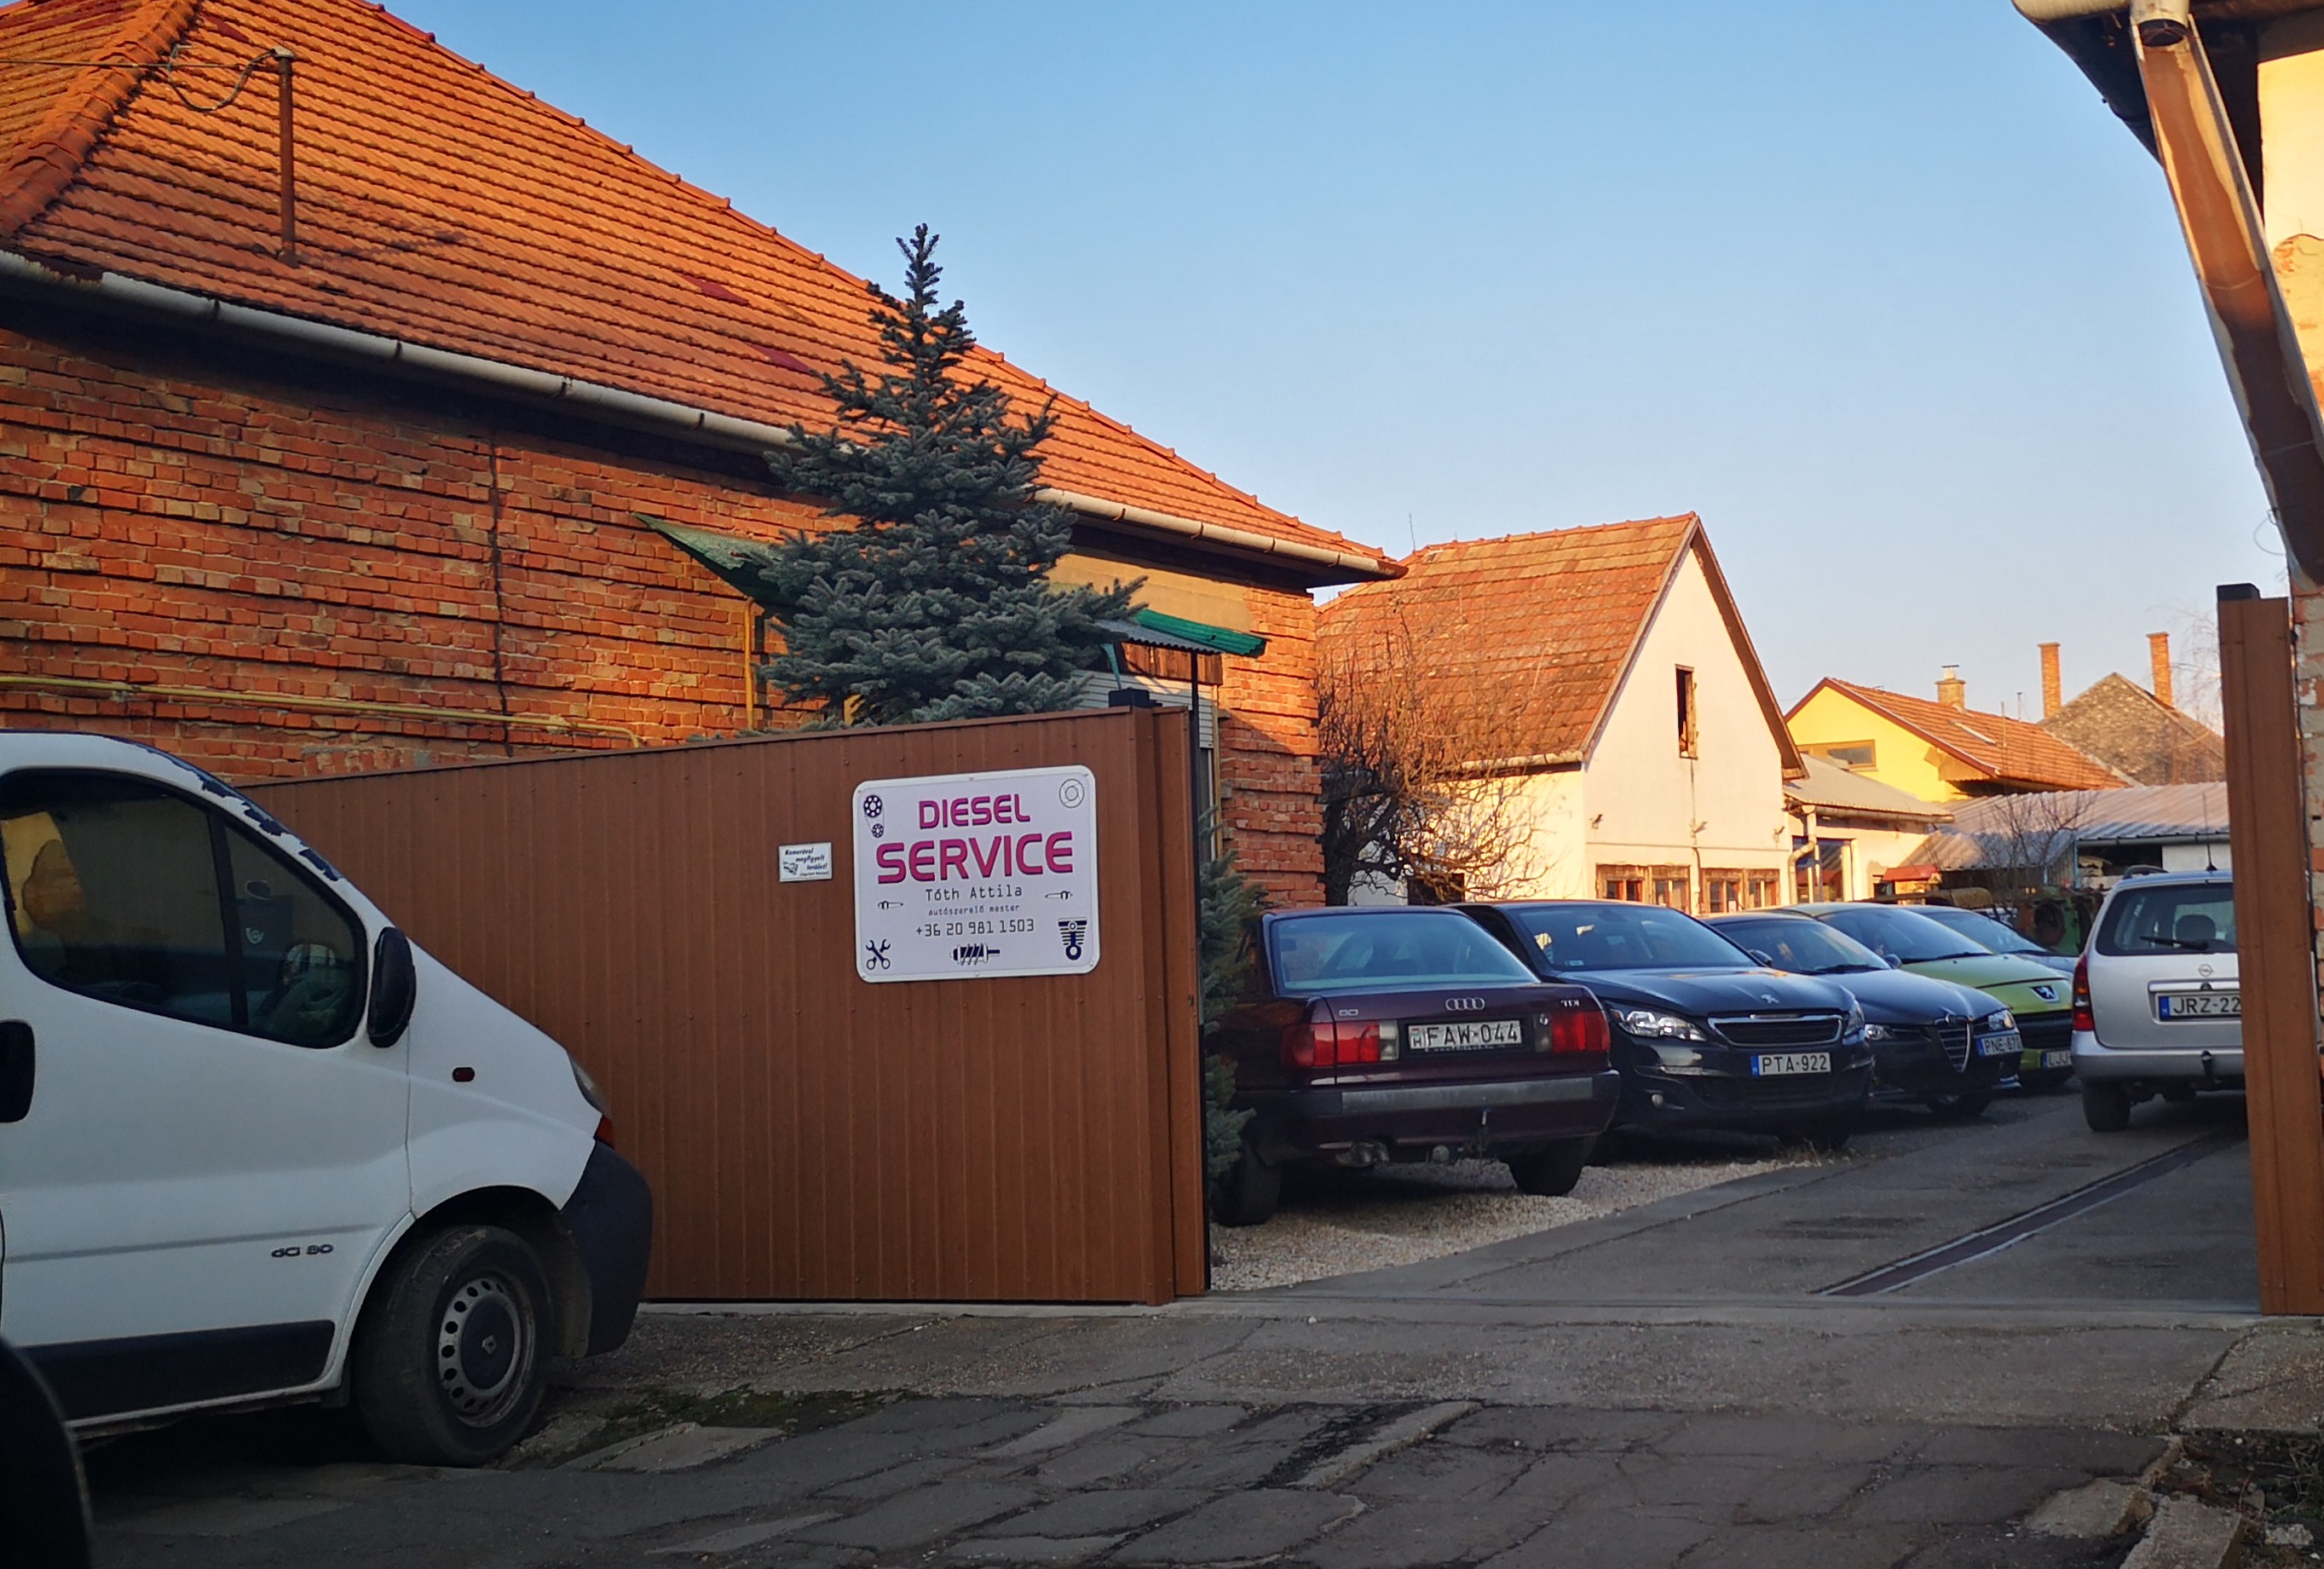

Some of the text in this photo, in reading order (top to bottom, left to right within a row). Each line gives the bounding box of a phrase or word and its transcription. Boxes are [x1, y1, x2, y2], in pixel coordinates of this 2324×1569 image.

[918, 793, 1031, 830] DIESEL
[875, 831, 1074, 885] SERVICE
[926, 884, 1023, 902] Tóth Attila
[928, 904, 1020, 916] autószerelő mester
[915, 919, 1035, 937] +36 20 981 1503
[2173, 996, 2241, 1014] JRZ-22
[1426, 1023, 1518, 1047] FAW-044
[1762, 1054, 1827, 1073] PTA-922
